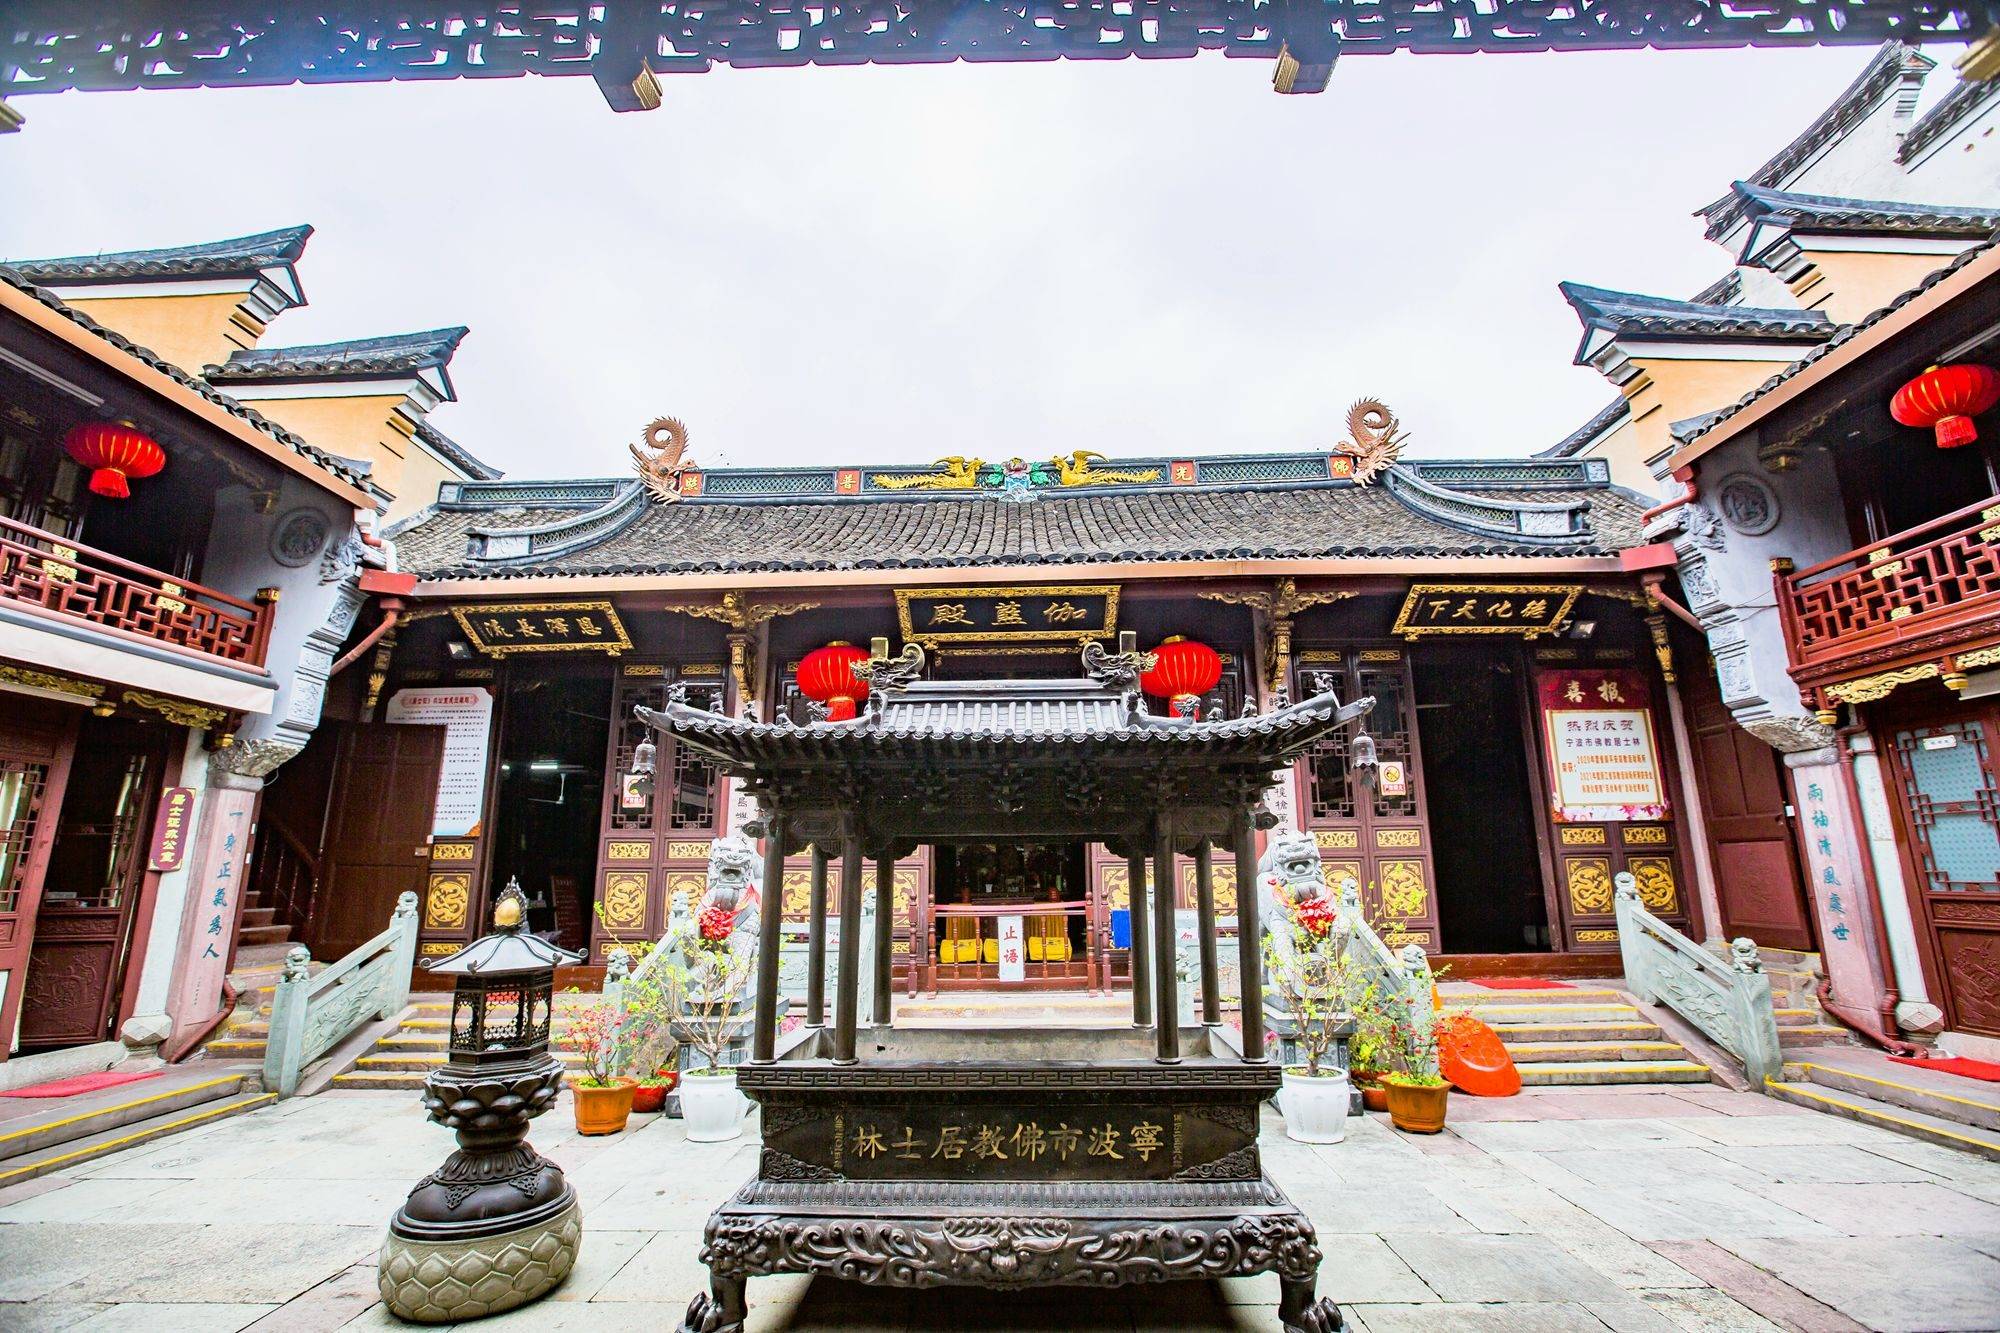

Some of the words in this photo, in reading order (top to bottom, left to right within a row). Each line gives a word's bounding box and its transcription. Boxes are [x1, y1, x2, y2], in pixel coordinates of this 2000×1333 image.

[840, 473, 857, 490] 普
[1174, 465, 1193, 481] 光
[927, 601, 1088, 626] 伽藍殿
[1428, 598, 1548, 620] 德化天下
[1564, 680, 1625, 703] 喜报
[1566, 719, 1634, 731] 热烈庆贺
[1565, 736, 1641, 748] 宁波市佛教居士林
[160, 794, 186, 863] 居士证办公室
[1004, 925, 1019, 963] 止语
[851, 1120, 1165, 1162] 寧波市佛教居士林
